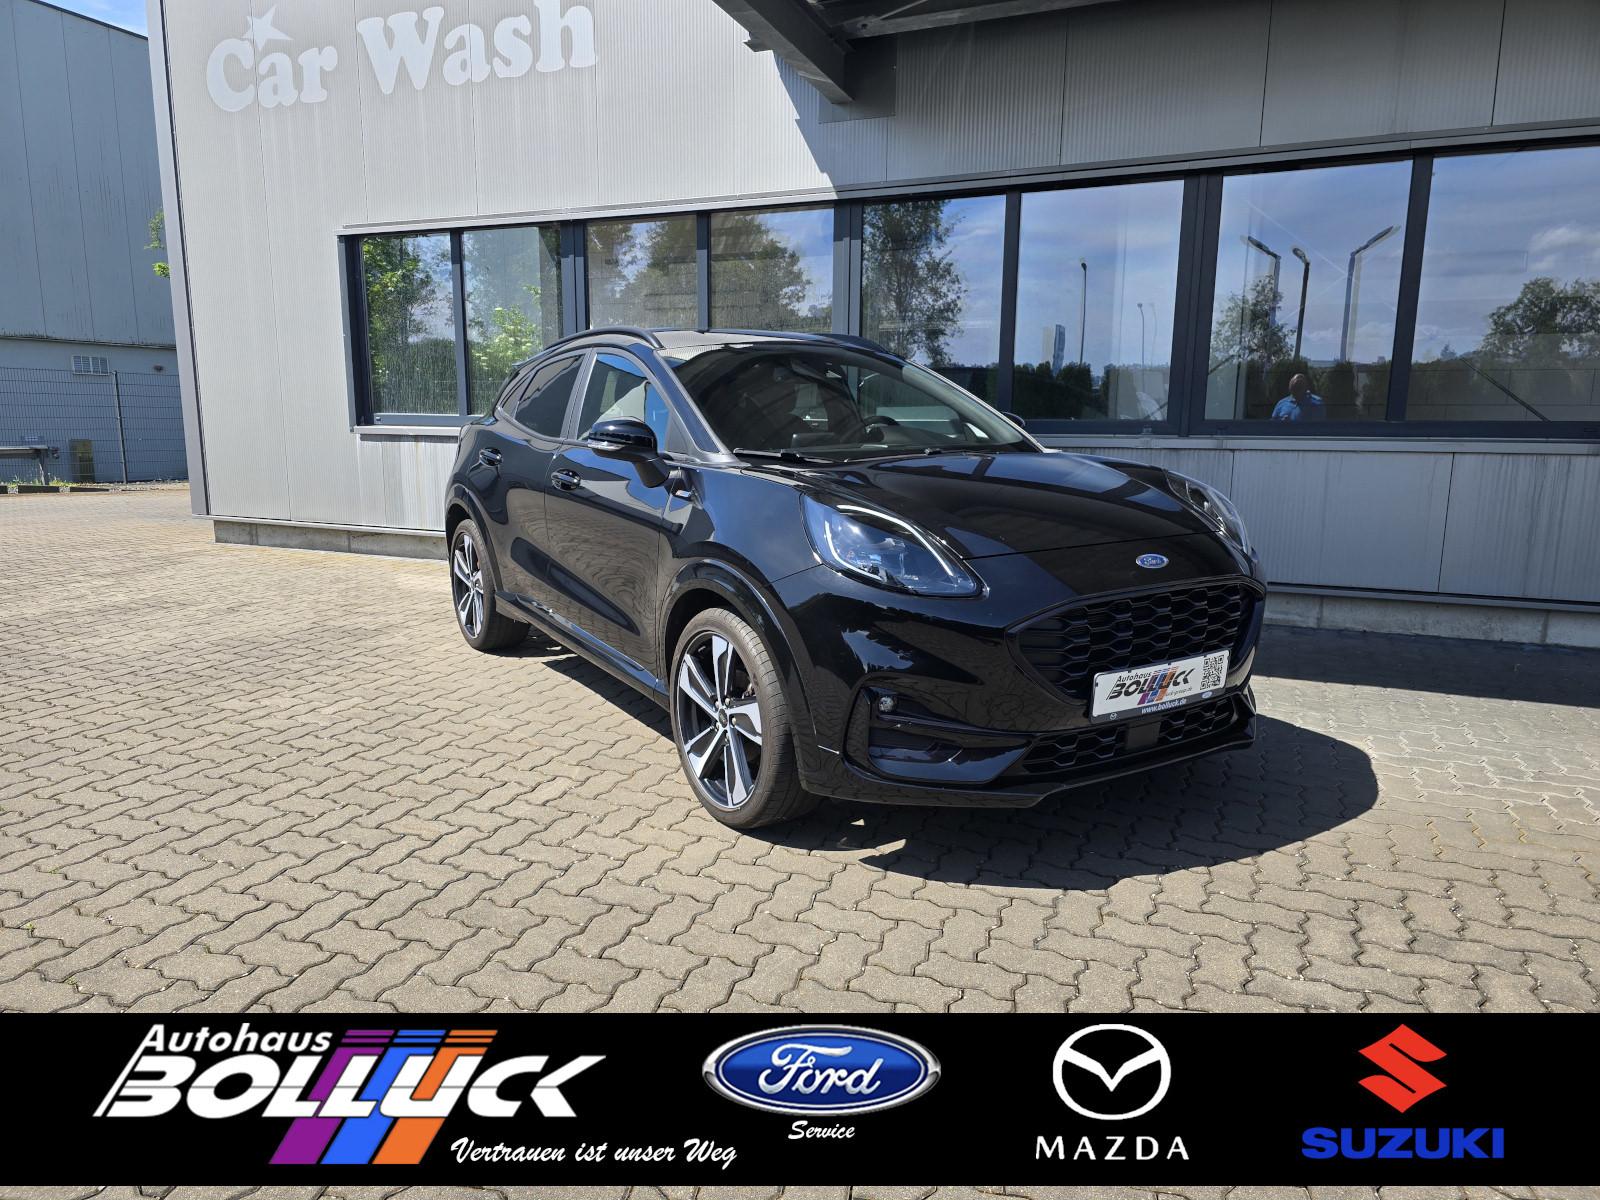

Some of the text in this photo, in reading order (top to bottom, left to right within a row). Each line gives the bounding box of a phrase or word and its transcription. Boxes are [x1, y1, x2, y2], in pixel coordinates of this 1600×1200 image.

[206, 0, 597, 112] Car Wash
[1117, 672, 1152, 682] Autohaus
